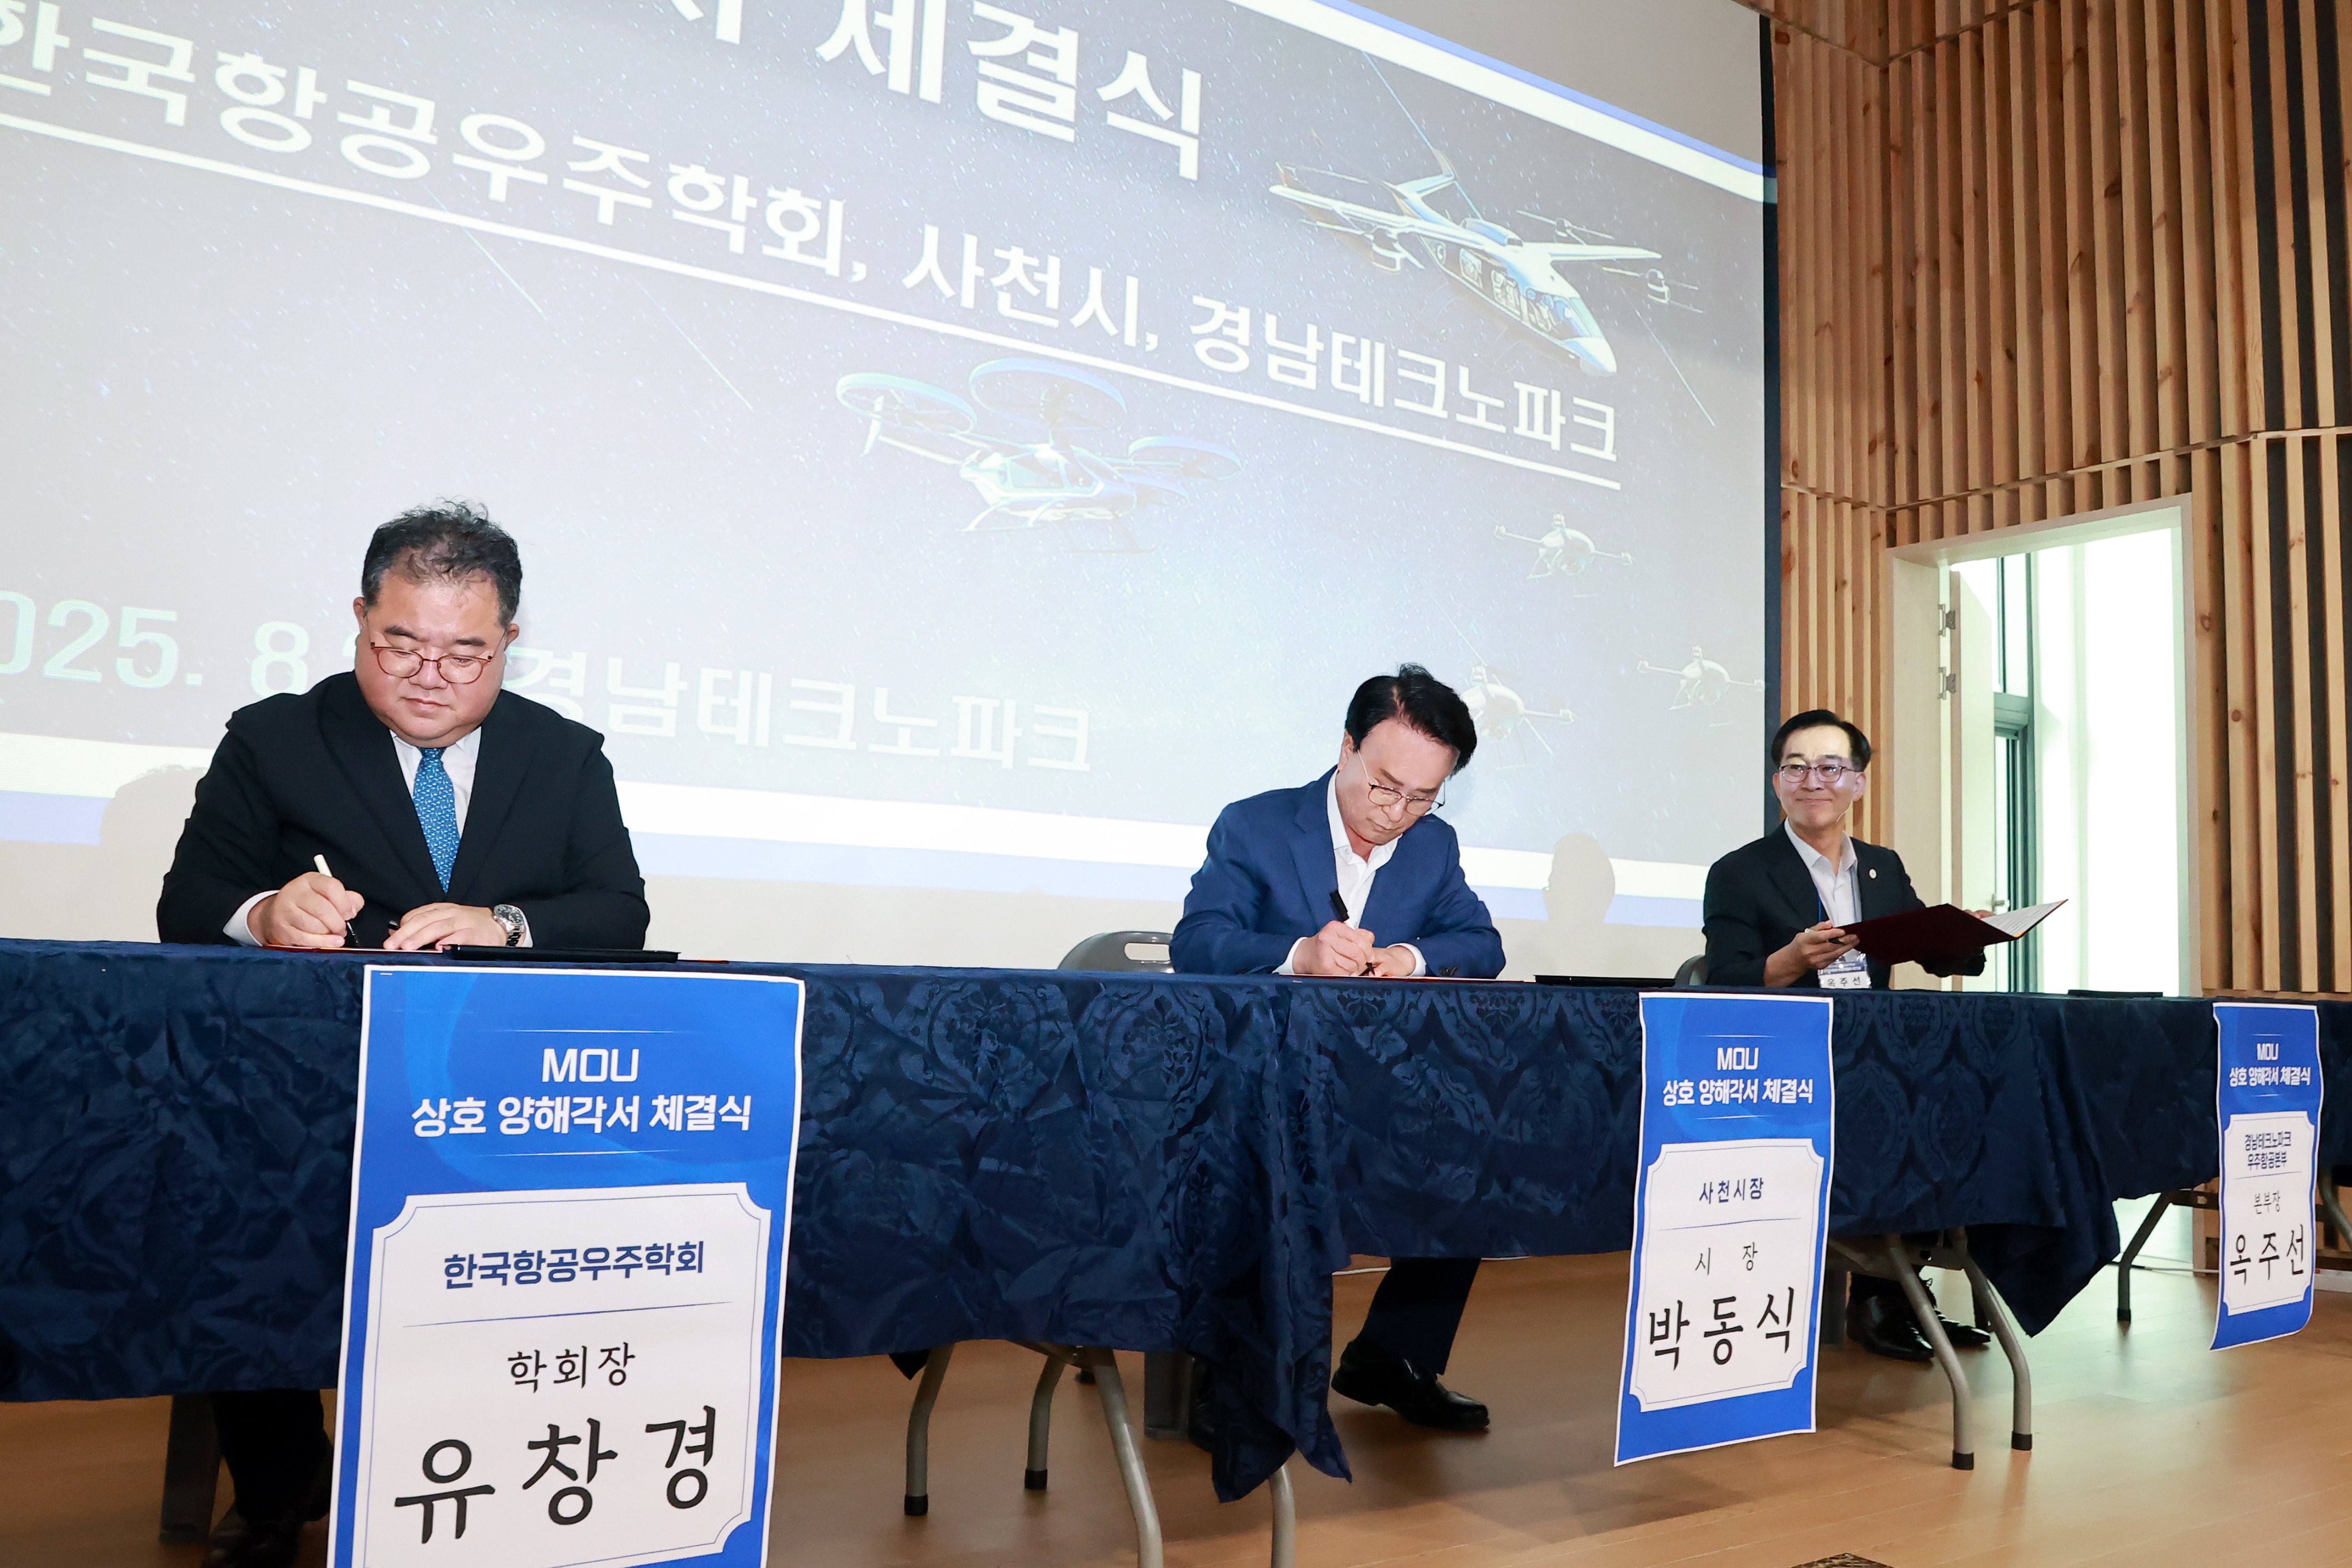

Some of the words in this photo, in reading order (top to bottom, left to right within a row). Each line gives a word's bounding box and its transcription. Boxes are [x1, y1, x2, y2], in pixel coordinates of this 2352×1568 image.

[902, 223, 1158, 352] 사천시,
[1191, 294, 1617, 462] 경남테크노파크
[503, 646, 1091, 772] 경남테크노파크
[541, 1048, 640, 1083] MOU
[1716, 1047, 1759, 1070] MOU
[2256, 1043, 2279, 1060] MOU
[1663, 1079, 1695, 1106] 상호
[1699, 1078, 1758, 1105] 양해각서
[1762, 1078, 1814, 1104] 체결식
[2229, 1067, 2247, 1087] 상호
[2249, 1067, 2279, 1086] 양해각서
[2280, 1066, 2311, 1086] 체결식
[411, 1096, 487, 1138] 상호
[497, 1095, 640, 1135] 양해각서
[649, 1094, 752, 1132] 체결식
[2245, 1132, 2291, 1151] 경남테크노파크
[2247, 1151, 2287, 1171] 우주항공본부
[1699, 1178, 1764, 1204] 사천시장
[2254, 1190, 2281, 1214] 본부장
[443, 1241, 705, 1289] 한국항공우주학회
[2230, 1224, 2304, 1286] 옥주선
[1649, 1286, 1794, 1371] 박동식
[508, 1342, 636, 1393] 학회장
[395, 1405, 716, 1544] 유창경
